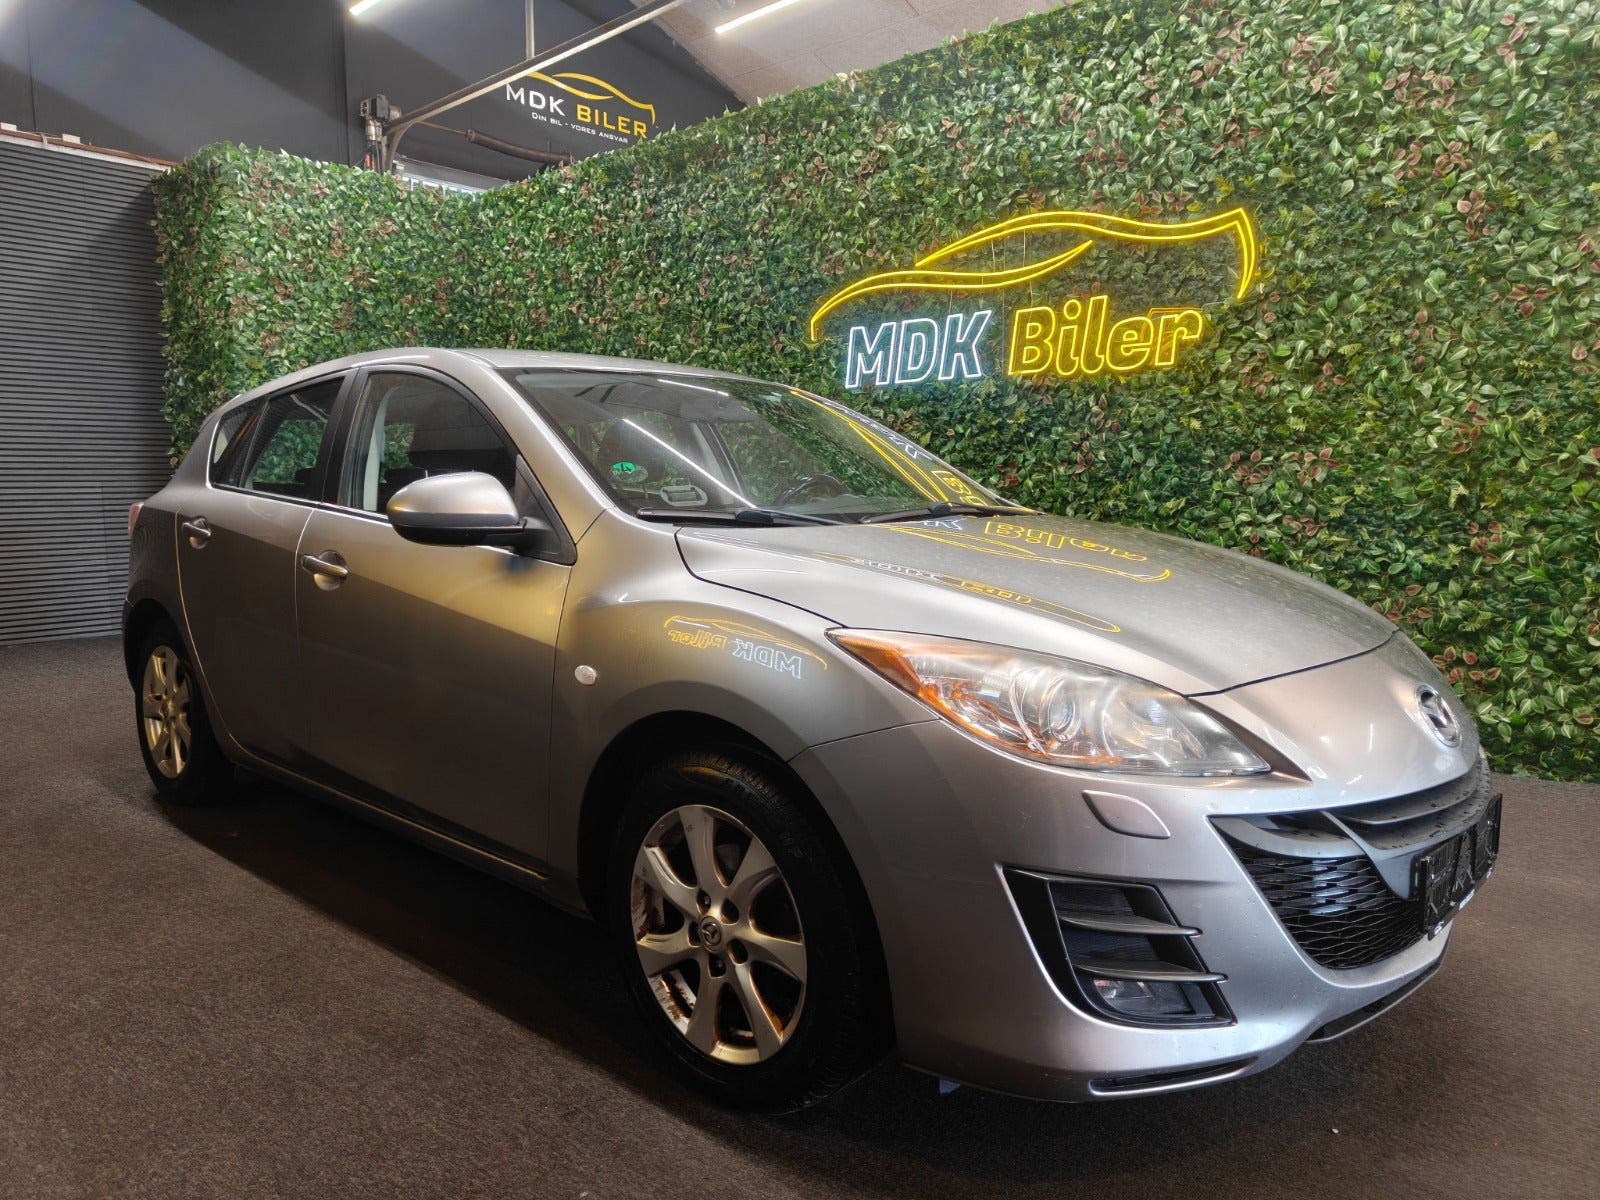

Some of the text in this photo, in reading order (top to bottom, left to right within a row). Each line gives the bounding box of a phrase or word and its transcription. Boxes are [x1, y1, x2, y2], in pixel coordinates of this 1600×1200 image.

[506, 84, 648, 139] MDK BILER
[571, 123, 596, 135] VORES
[599, 131, 628, 144] ANSVAR
[844, 294, 1204, 390] MDK Biler
